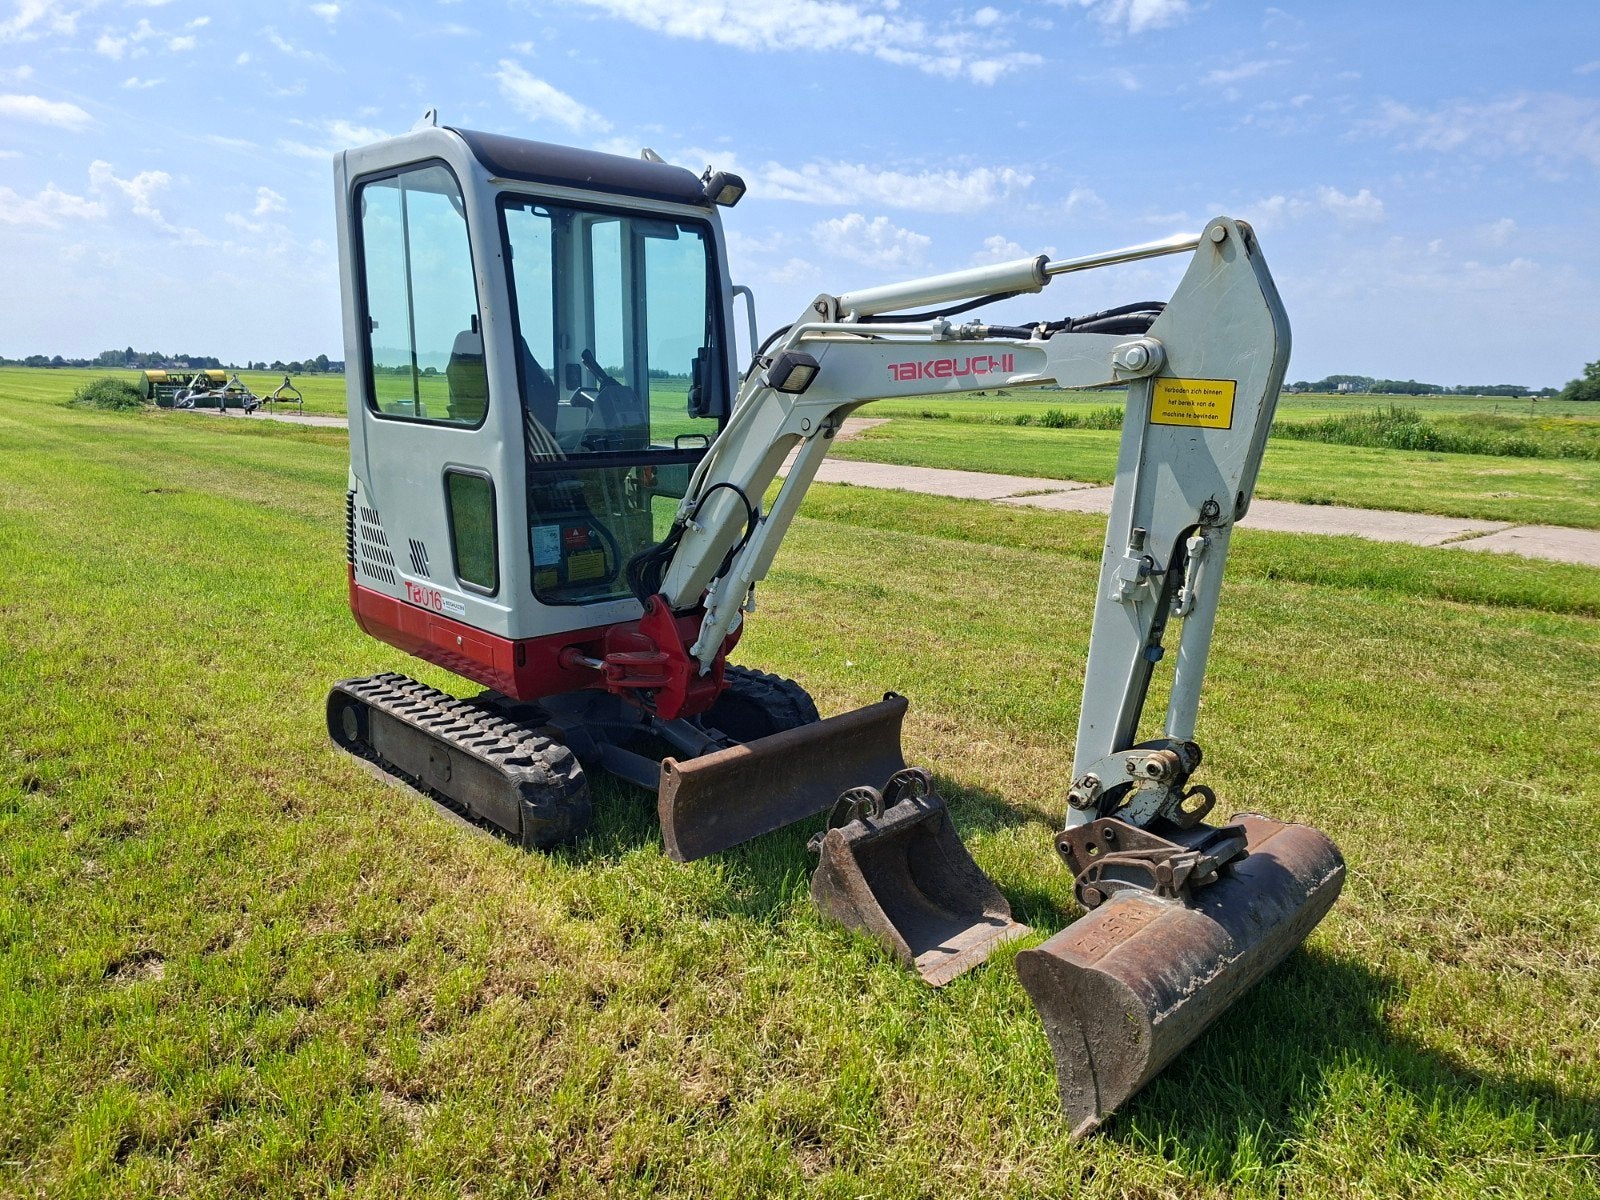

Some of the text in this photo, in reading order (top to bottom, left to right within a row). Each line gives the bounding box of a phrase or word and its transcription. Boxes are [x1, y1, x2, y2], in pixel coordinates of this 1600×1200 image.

[1203, 388, 1223, 396] binnen
[1162, 410, 1185, 418] machine
[404, 581, 442, 611] TB016
